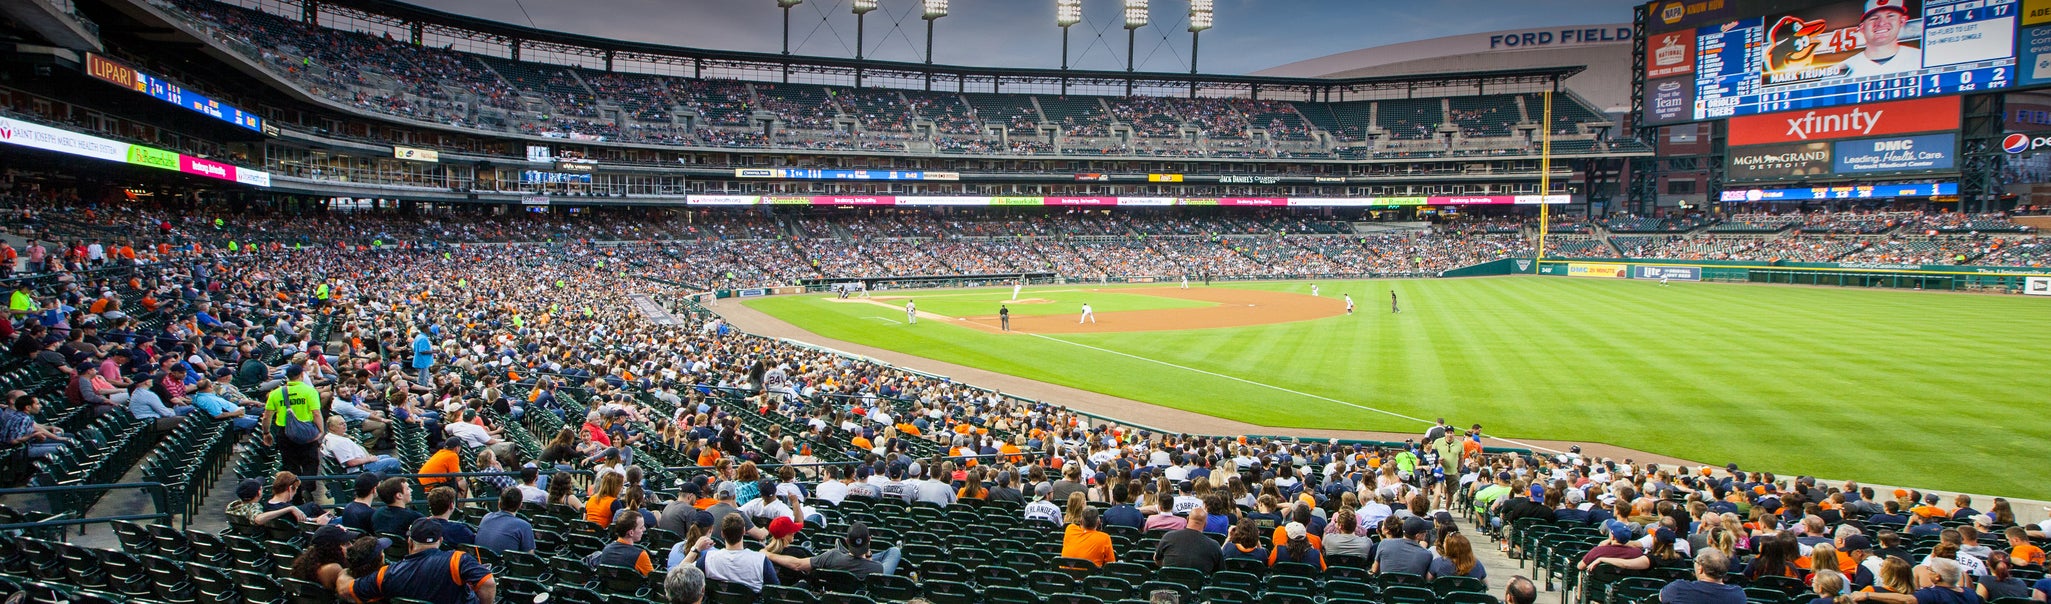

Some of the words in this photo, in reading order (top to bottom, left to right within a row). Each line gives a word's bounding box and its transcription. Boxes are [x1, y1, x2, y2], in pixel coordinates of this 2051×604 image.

[1664, 8, 1682, 20] NAPA
[1687, 3, 1707, 14] KNOW
[1926, 14, 1952, 26] .236
[1964, 10, 1974, 20] 4
[1994, 5, 2009, 16] 17
[1490, 31, 1553, 48] FORD
[1561, 28, 1632, 43] FIELD
[1829, 28, 1857, 51] 45
[1658, 49, 1683, 59] NATIONAL
[95, 58, 131, 87] LIPARI
[1771, 71, 1798, 83] MARK
[1800, 66, 1840, 80] TRUMBO
[1930, 75, 1940, 87] 1
[1960, 71, 1973, 84] 0
[1992, 68, 2006, 81] 2
[1707, 96, 1740, 108] ORIOLES
[1864, 82, 1872, 90] 7
[1908, 77, 1916, 86] 3
[1654, 98, 1682, 108] Team
[1707, 107, 1735, 117] TIGERS
[1863, 92, 1871, 101] 4
[1786, 107, 1883, 139] xfinity
[13, 127, 33, 139] SAINT
[34, 130, 57, 144] JOSEPH
[57, 135, 77, 148] MERCY
[78, 139, 99, 151] HEALTH
[99, 143, 117, 155] SYSTEM
[1874, 140, 1914, 151] DMC
[1733, 155, 1765, 166] MGM
[1781, 151, 1826, 162] GRAND
[1918, 151, 1945, 160] Care.
[1749, 162, 1809, 171] DETROIT
[1219, 175, 1232, 183] JACK
[1232, 175, 1253, 183] DANIEL'S
[1643, 267, 1661, 278] Lite
[769, 375, 780, 385] 24
